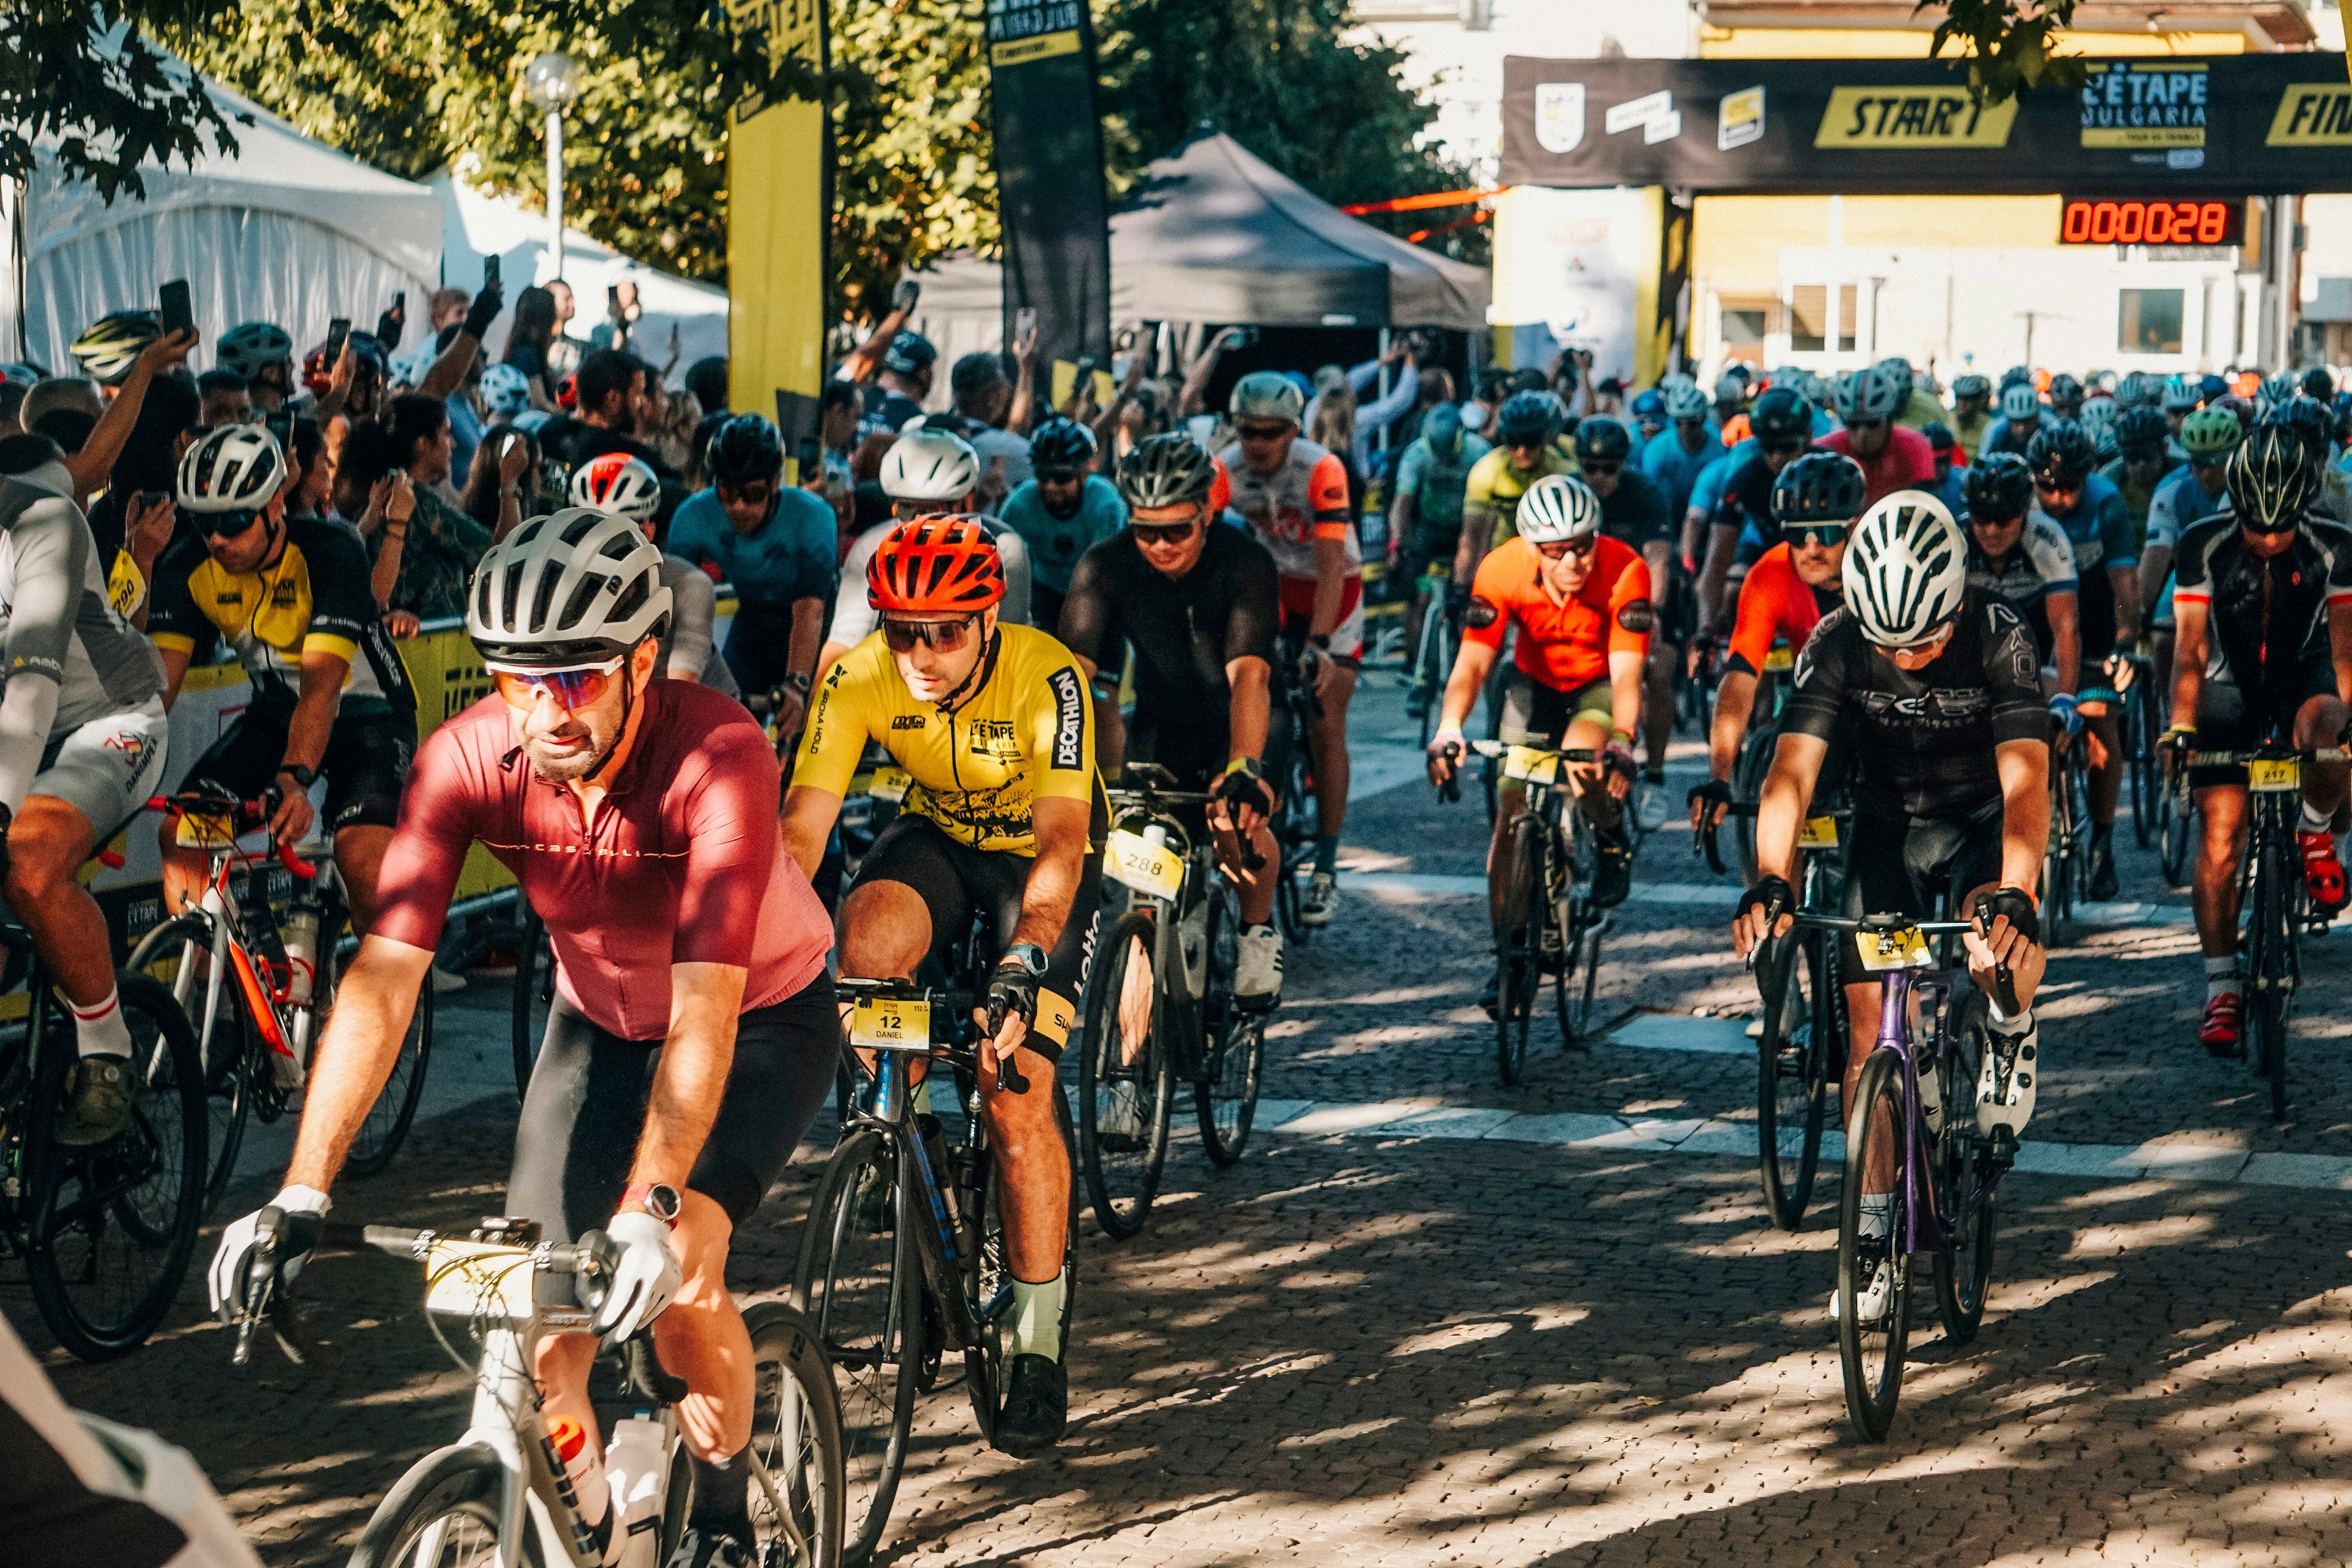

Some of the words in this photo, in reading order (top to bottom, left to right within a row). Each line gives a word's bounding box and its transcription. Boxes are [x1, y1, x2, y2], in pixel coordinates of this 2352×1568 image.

[1055, 671, 1080, 765] DECATHLON
[810, 727, 823, 754] HOLD
[1125, 853, 1162, 876] 288
[880, 1015, 902, 1029] 12
[876, 1030, 904, 1039] DANIEL
